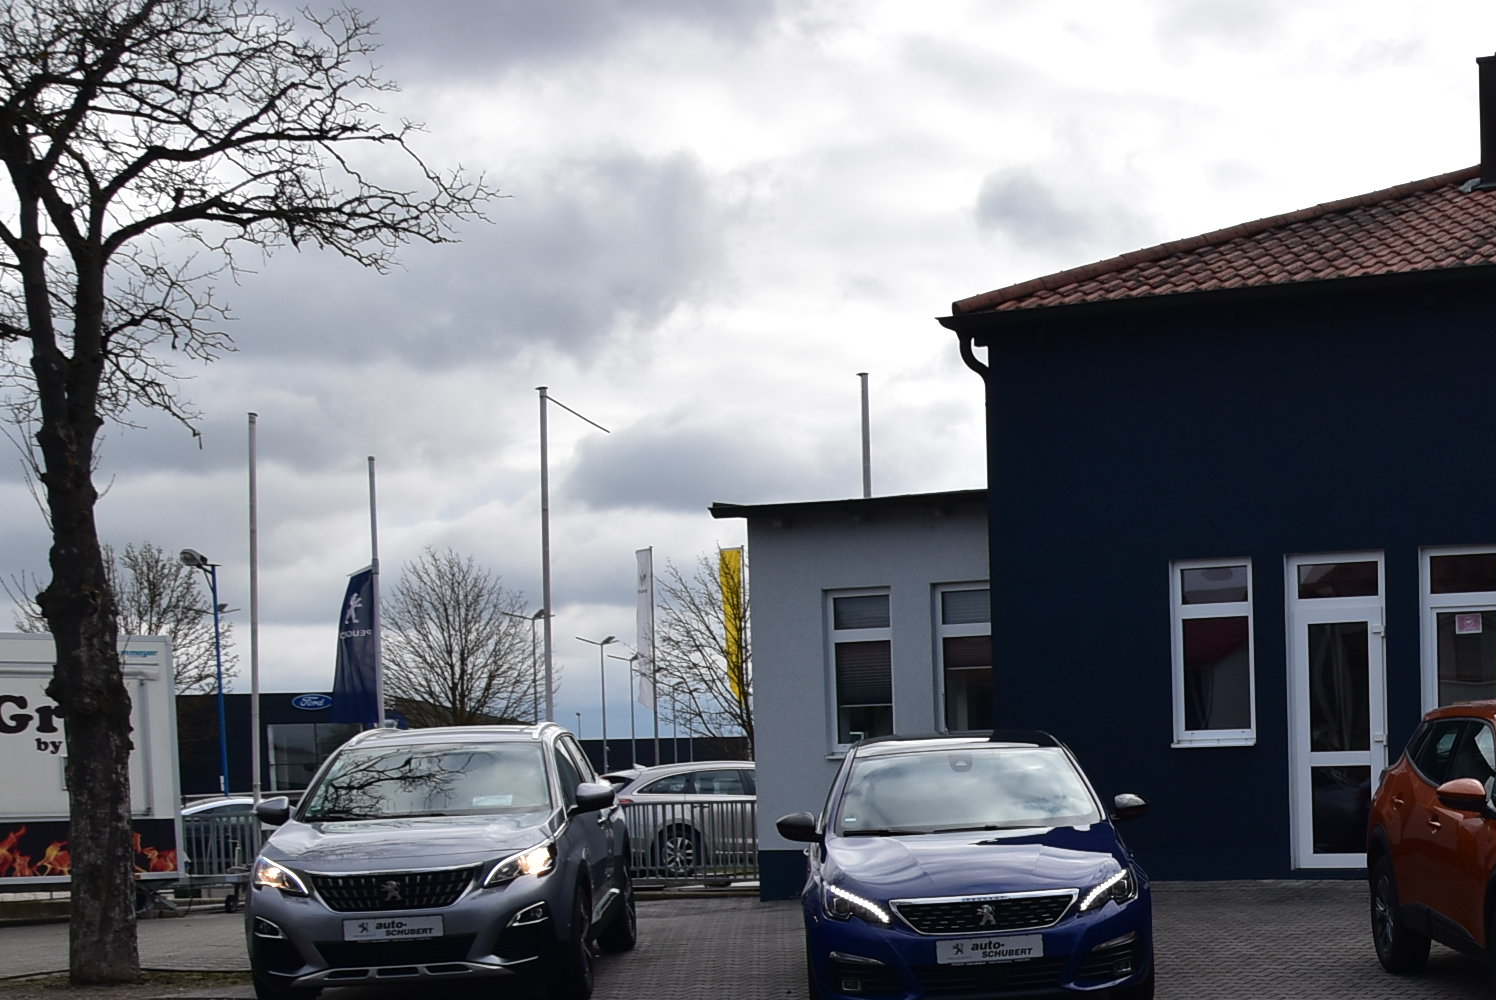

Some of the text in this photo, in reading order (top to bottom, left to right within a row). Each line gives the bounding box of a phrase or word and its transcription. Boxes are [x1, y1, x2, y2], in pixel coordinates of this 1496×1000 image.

[35, 738, 62, 754] by
[375, 920, 407, 930] auto-
[385, 927, 434, 937] SCHUBERT
[971, 940, 1005, 951] auto-
[982, 947, 1033, 959] SCHUBERT
